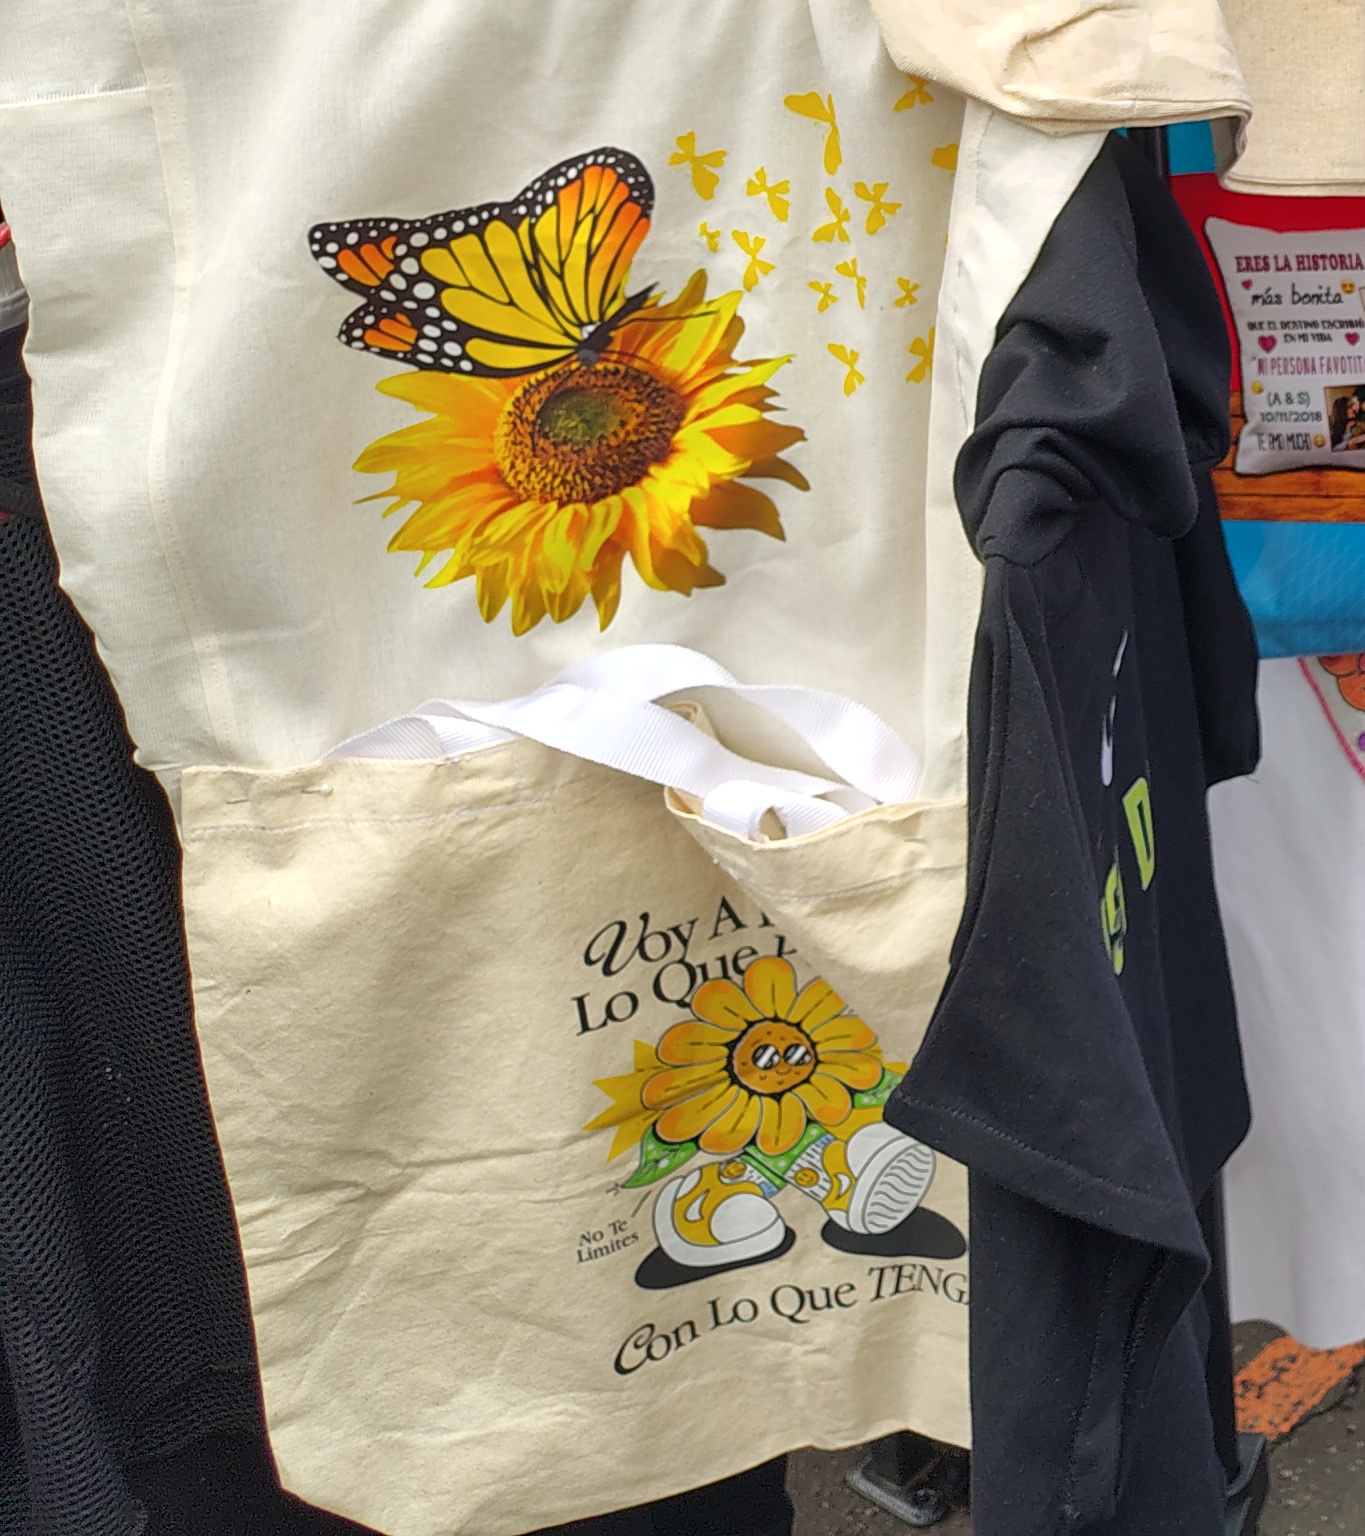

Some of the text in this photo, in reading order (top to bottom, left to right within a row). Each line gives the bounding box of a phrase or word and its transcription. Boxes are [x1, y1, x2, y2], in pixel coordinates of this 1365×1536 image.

[1234, 252, 1365, 273] ERES LA HISTORIA
[1291, 281, 1345, 306] bonita
[583, 894, 749, 977] Voy A
[570, 991, 639, 1037] Lo
[652, 945, 758, 1009] Que
[576, 1229, 640, 1264] Limites
[578, 1228, 604, 1246] No
[613, 1262, 970, 1375] Con Lo Que TENG
